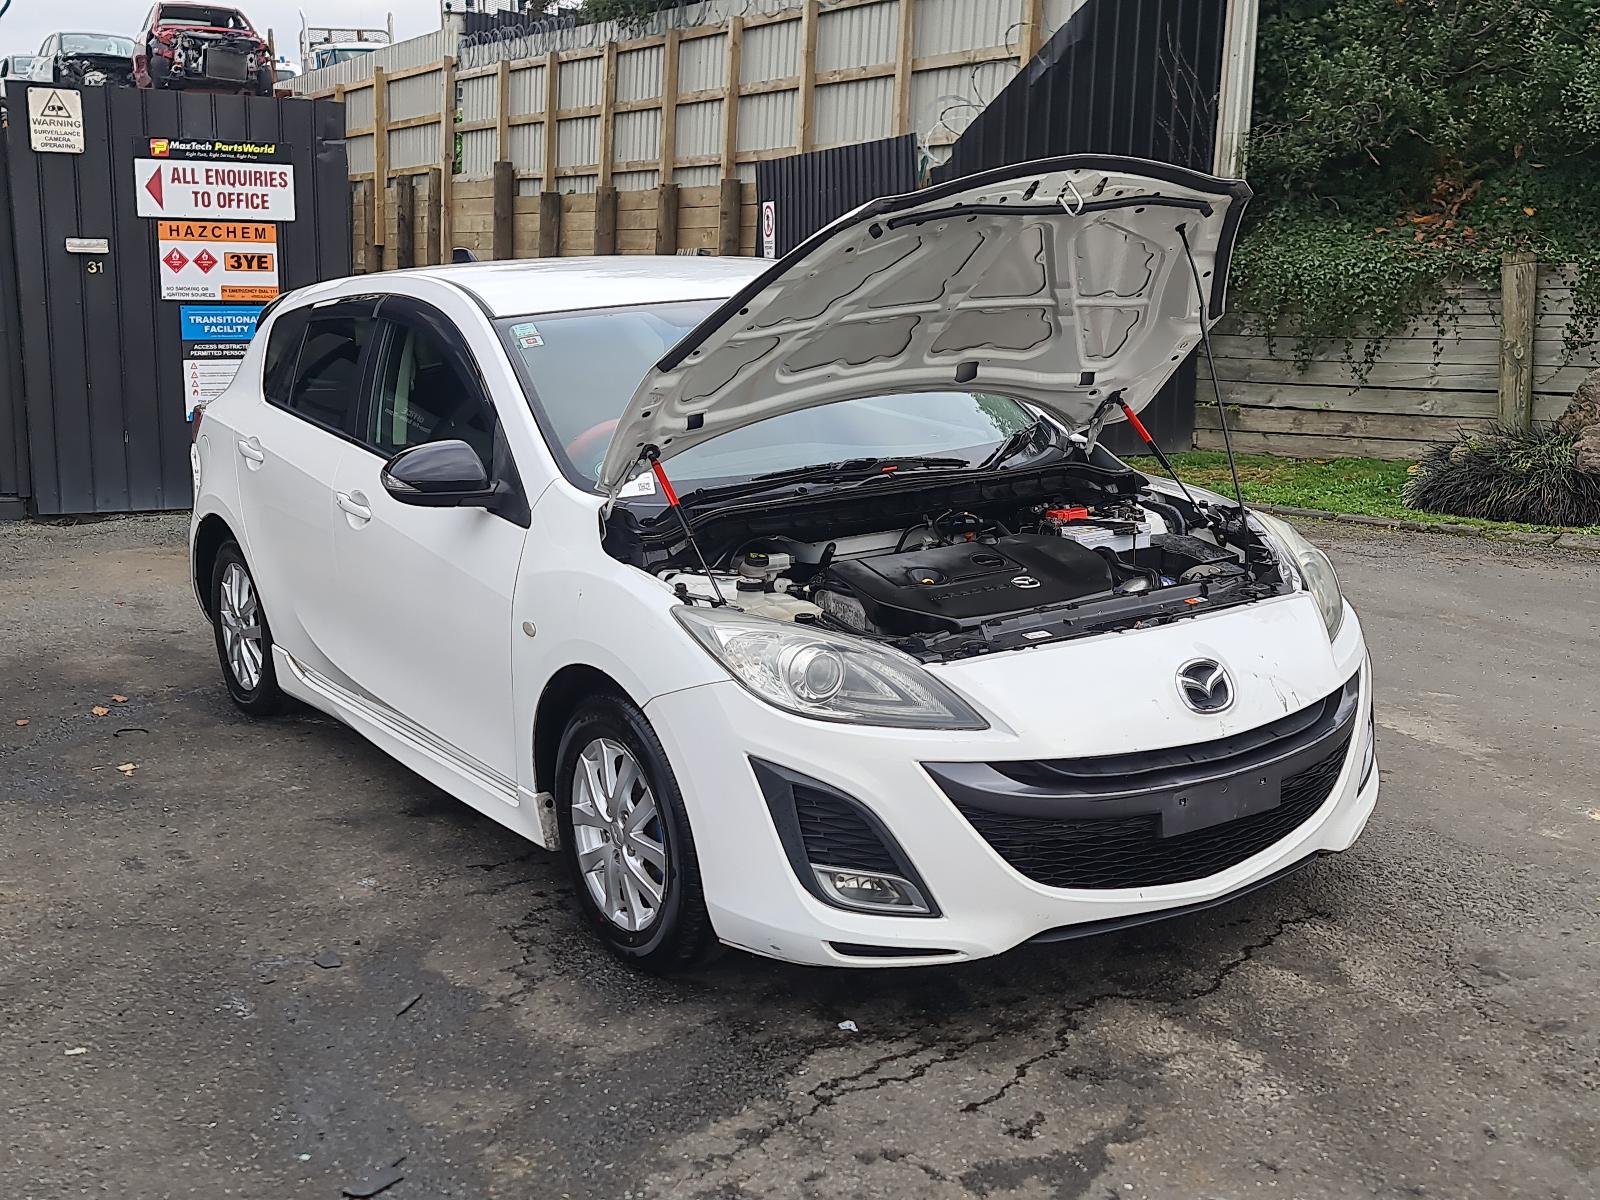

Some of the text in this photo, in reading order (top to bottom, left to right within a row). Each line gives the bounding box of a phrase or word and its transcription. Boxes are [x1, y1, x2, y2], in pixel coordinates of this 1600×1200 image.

[32, 118, 81, 128] WARNING
[34, 129, 80, 137] SURVEILLANCE
[170, 141, 275, 154] MazTech PartsWorld
[171, 167, 288, 188] ALL ENQUIRIES
[192, 191, 270, 210] TO OFFICE
[169, 224, 267, 240] HAZCHEM
[87, 261, 104, 274] 31
[230, 254, 269, 270] 3YE
[189, 315, 259, 324] TRANSITIONA
[204, 325, 249, 333] FACILITY
